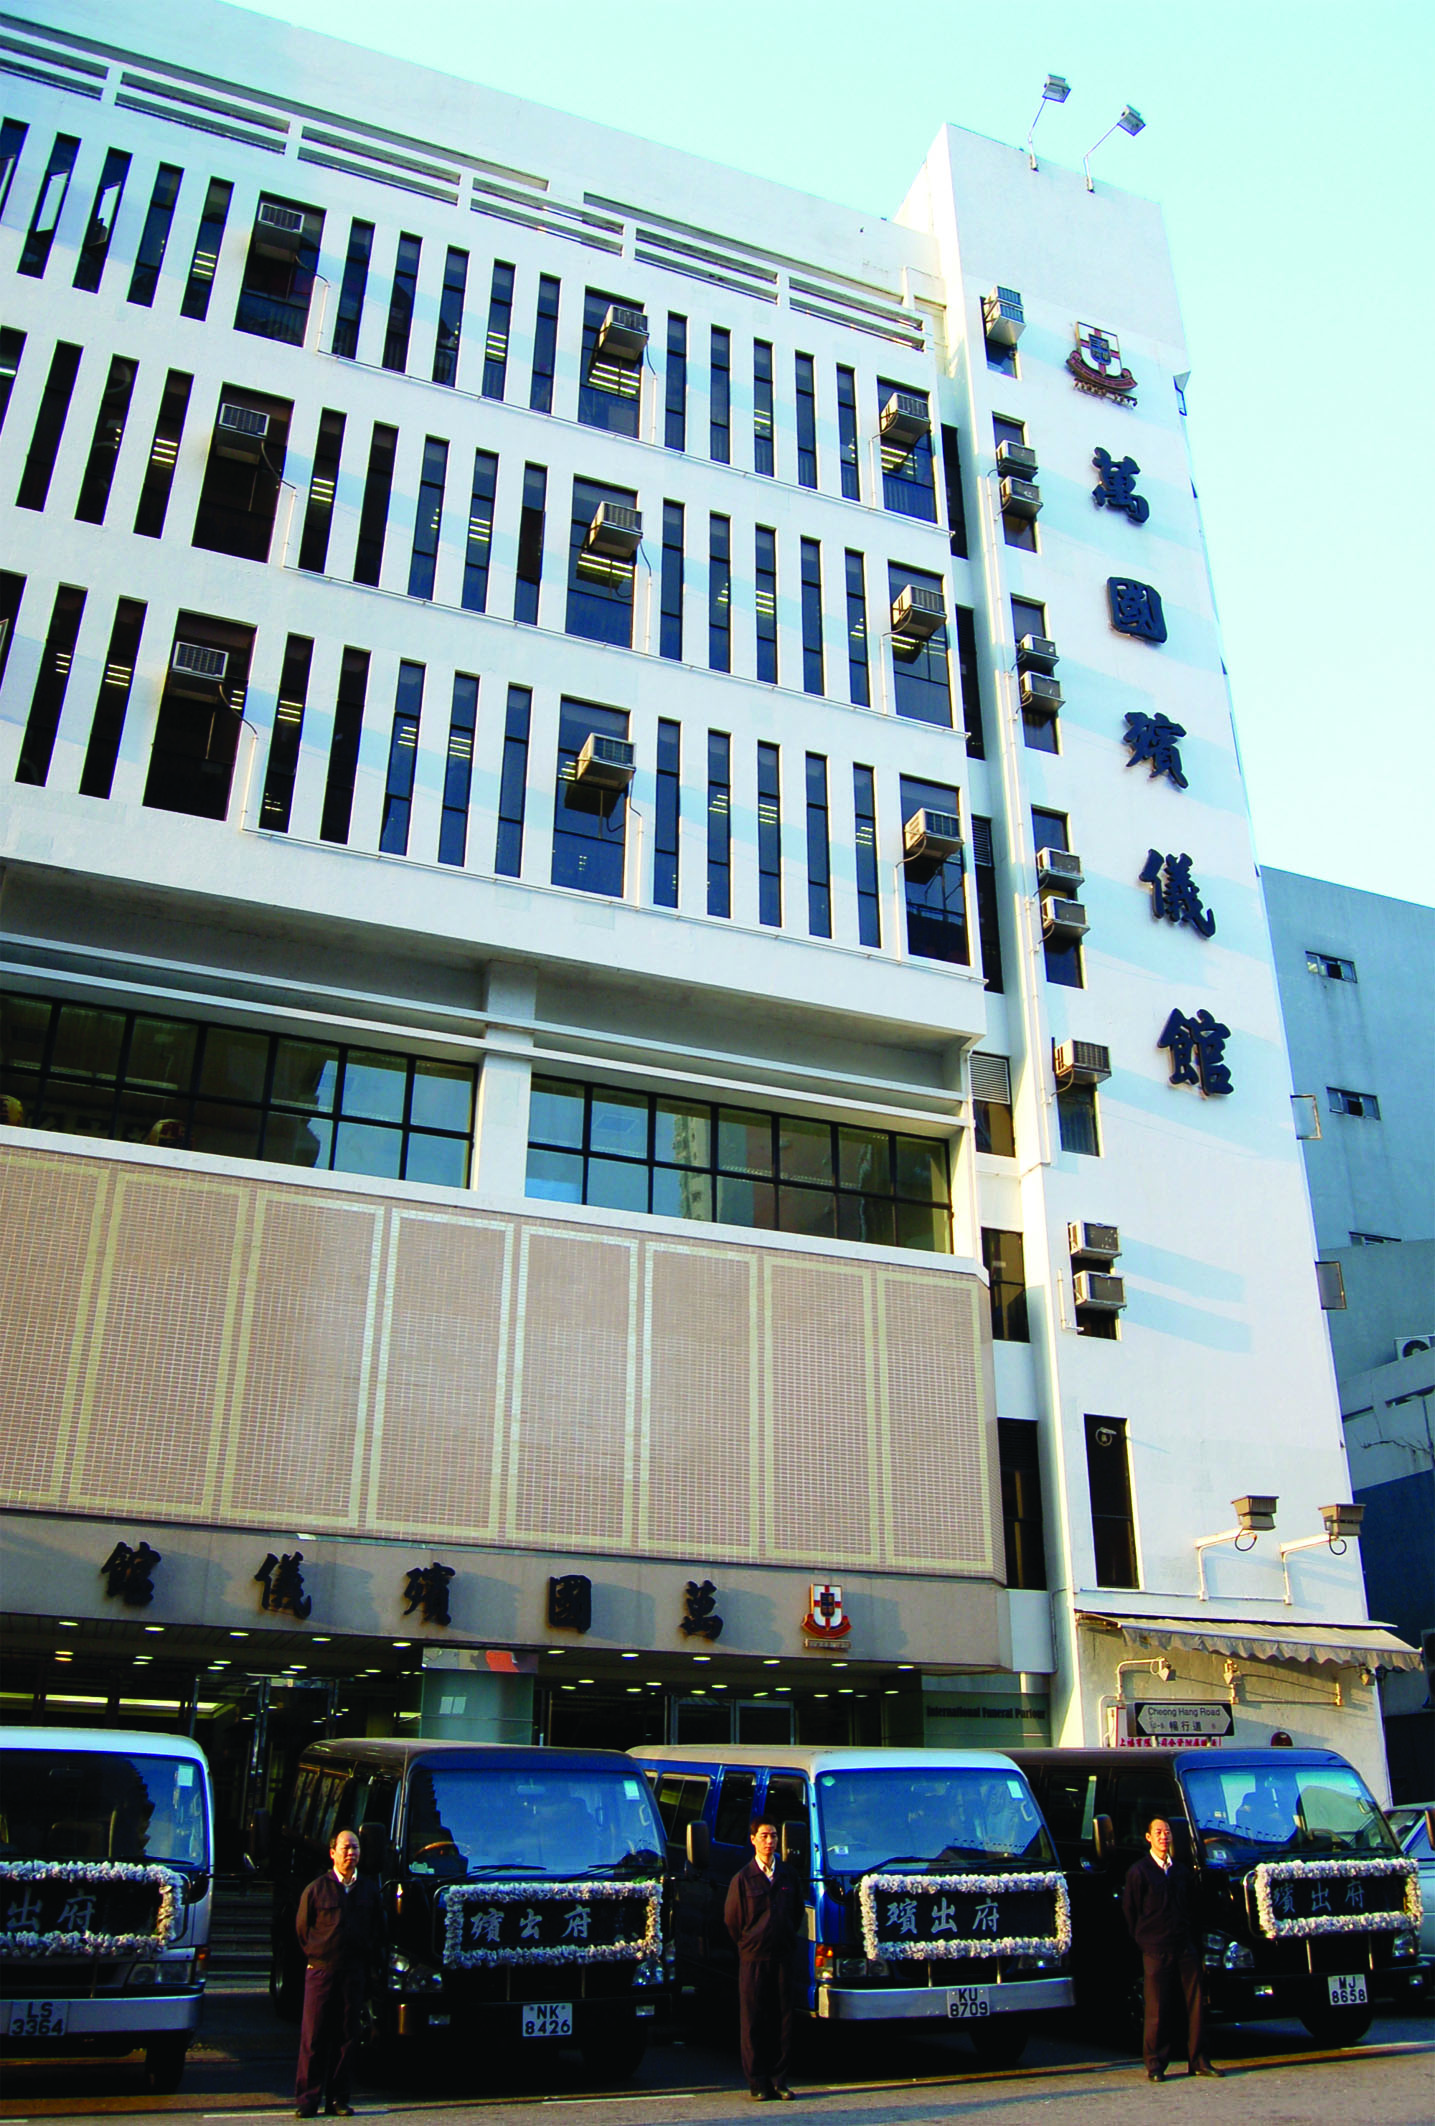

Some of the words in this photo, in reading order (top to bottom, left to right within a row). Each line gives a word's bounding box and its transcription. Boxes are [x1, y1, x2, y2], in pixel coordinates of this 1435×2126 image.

[1147, 1707, 1177, 1717] Cheong
[1178, 1707, 1198, 1717] Hang
[1200, 1707, 1220, 1716] Road
[1338, 1976, 1357, 1990] MJ
[958, 1987, 978, 2001] KU
[1331, 1989, 1367, 2004] 8658
[27, 2001, 53, 2018] LS
[536, 2005, 560, 2020] NK
[950, 2001, 989, 2017] 8709
[11, 2018, 64, 2036] 3364
[524, 2019, 571, 2035] 8426
